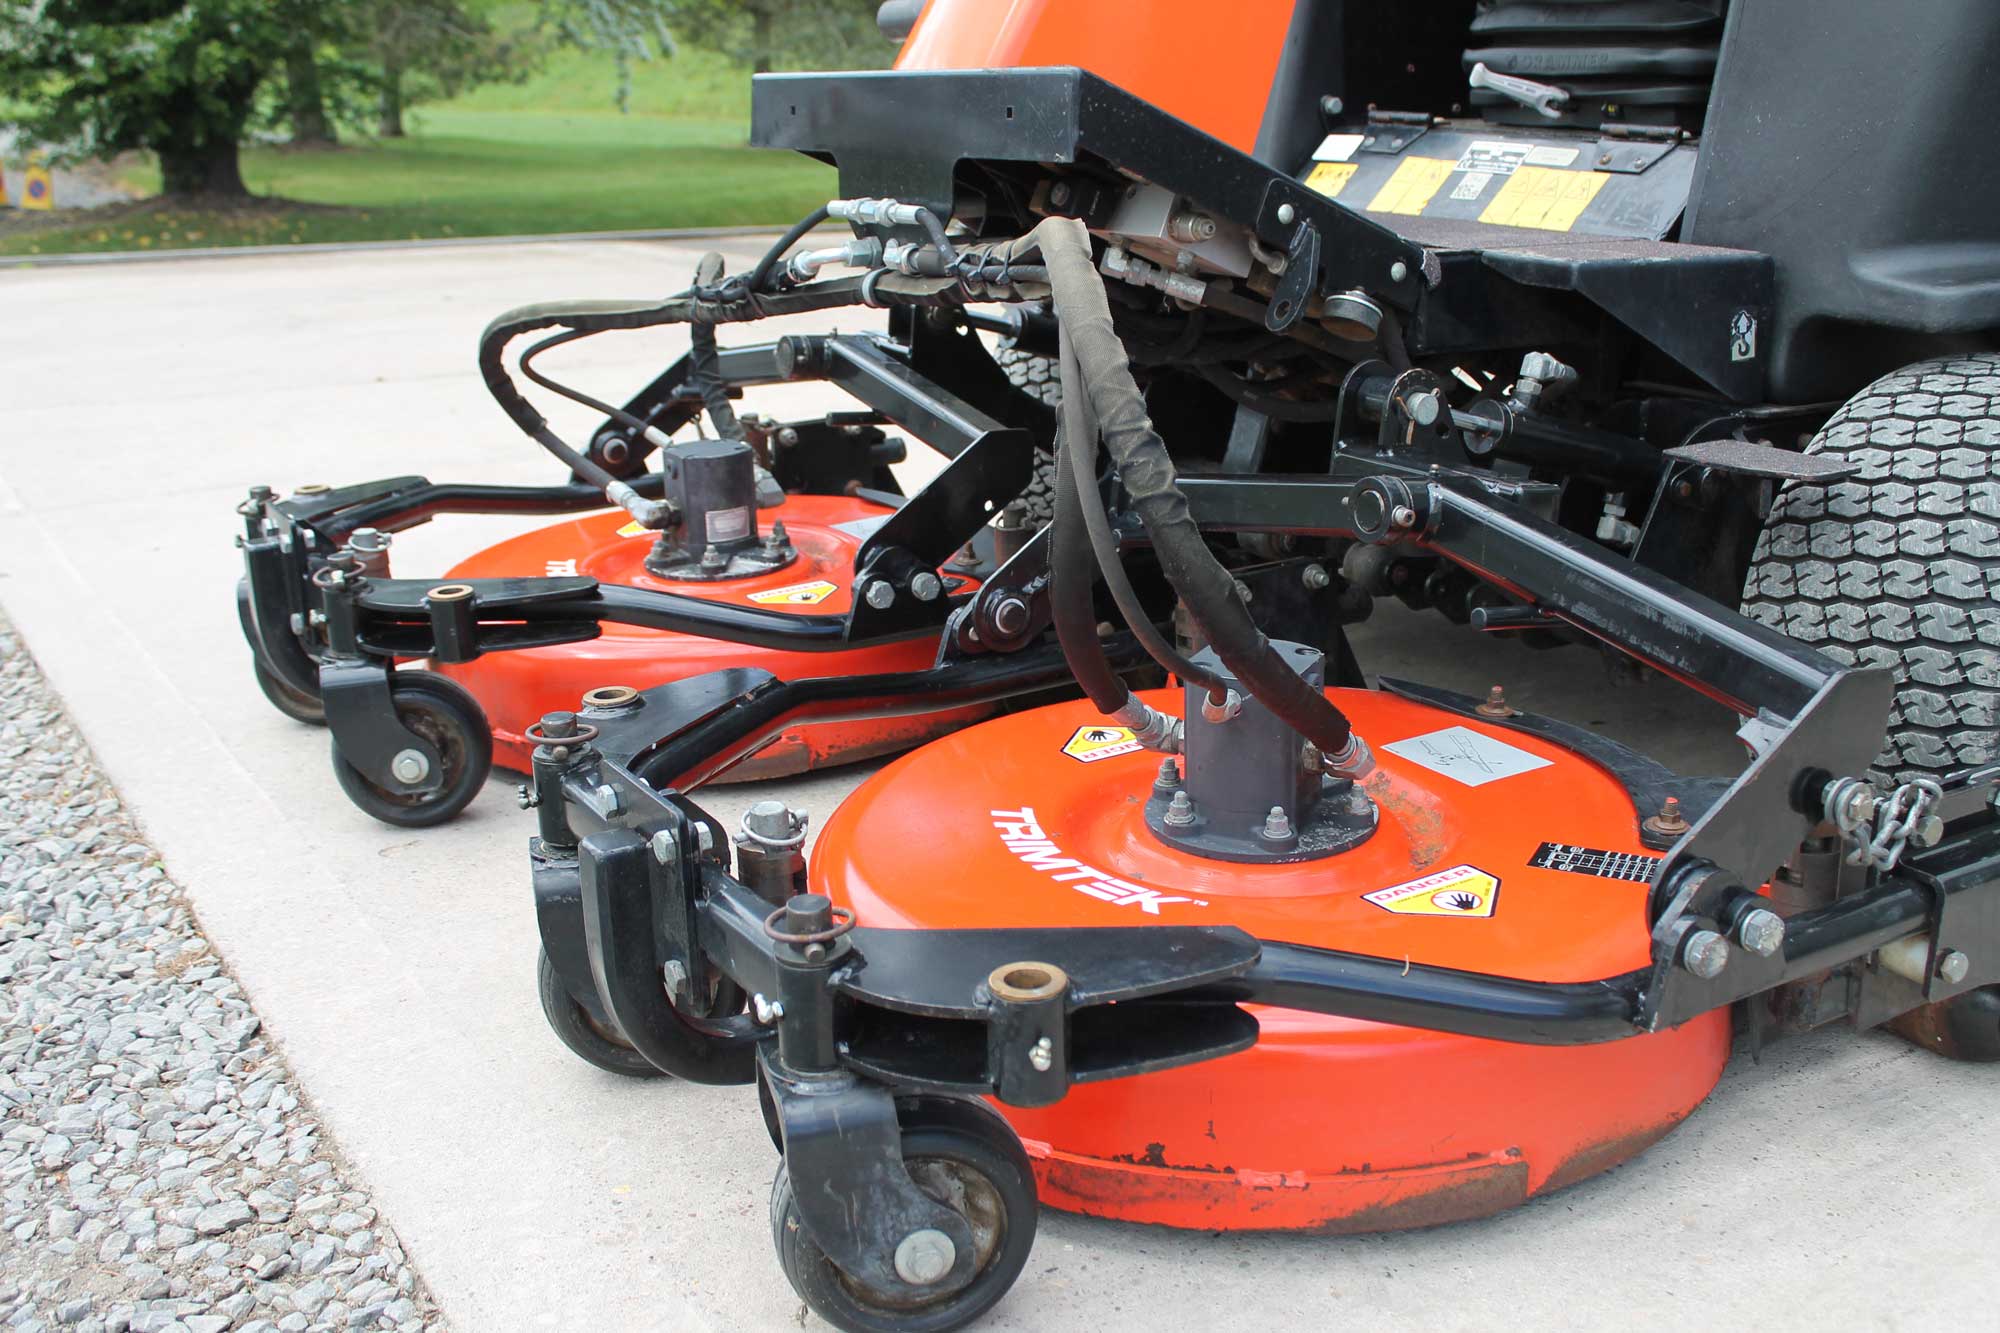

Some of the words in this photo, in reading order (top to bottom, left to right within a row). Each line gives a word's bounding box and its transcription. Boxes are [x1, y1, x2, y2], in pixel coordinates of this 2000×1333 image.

[1082, 741, 1141, 760] NGER
[990, 807, 1193, 915] TRIMTEK
[1373, 868, 1473, 901] DANGER
